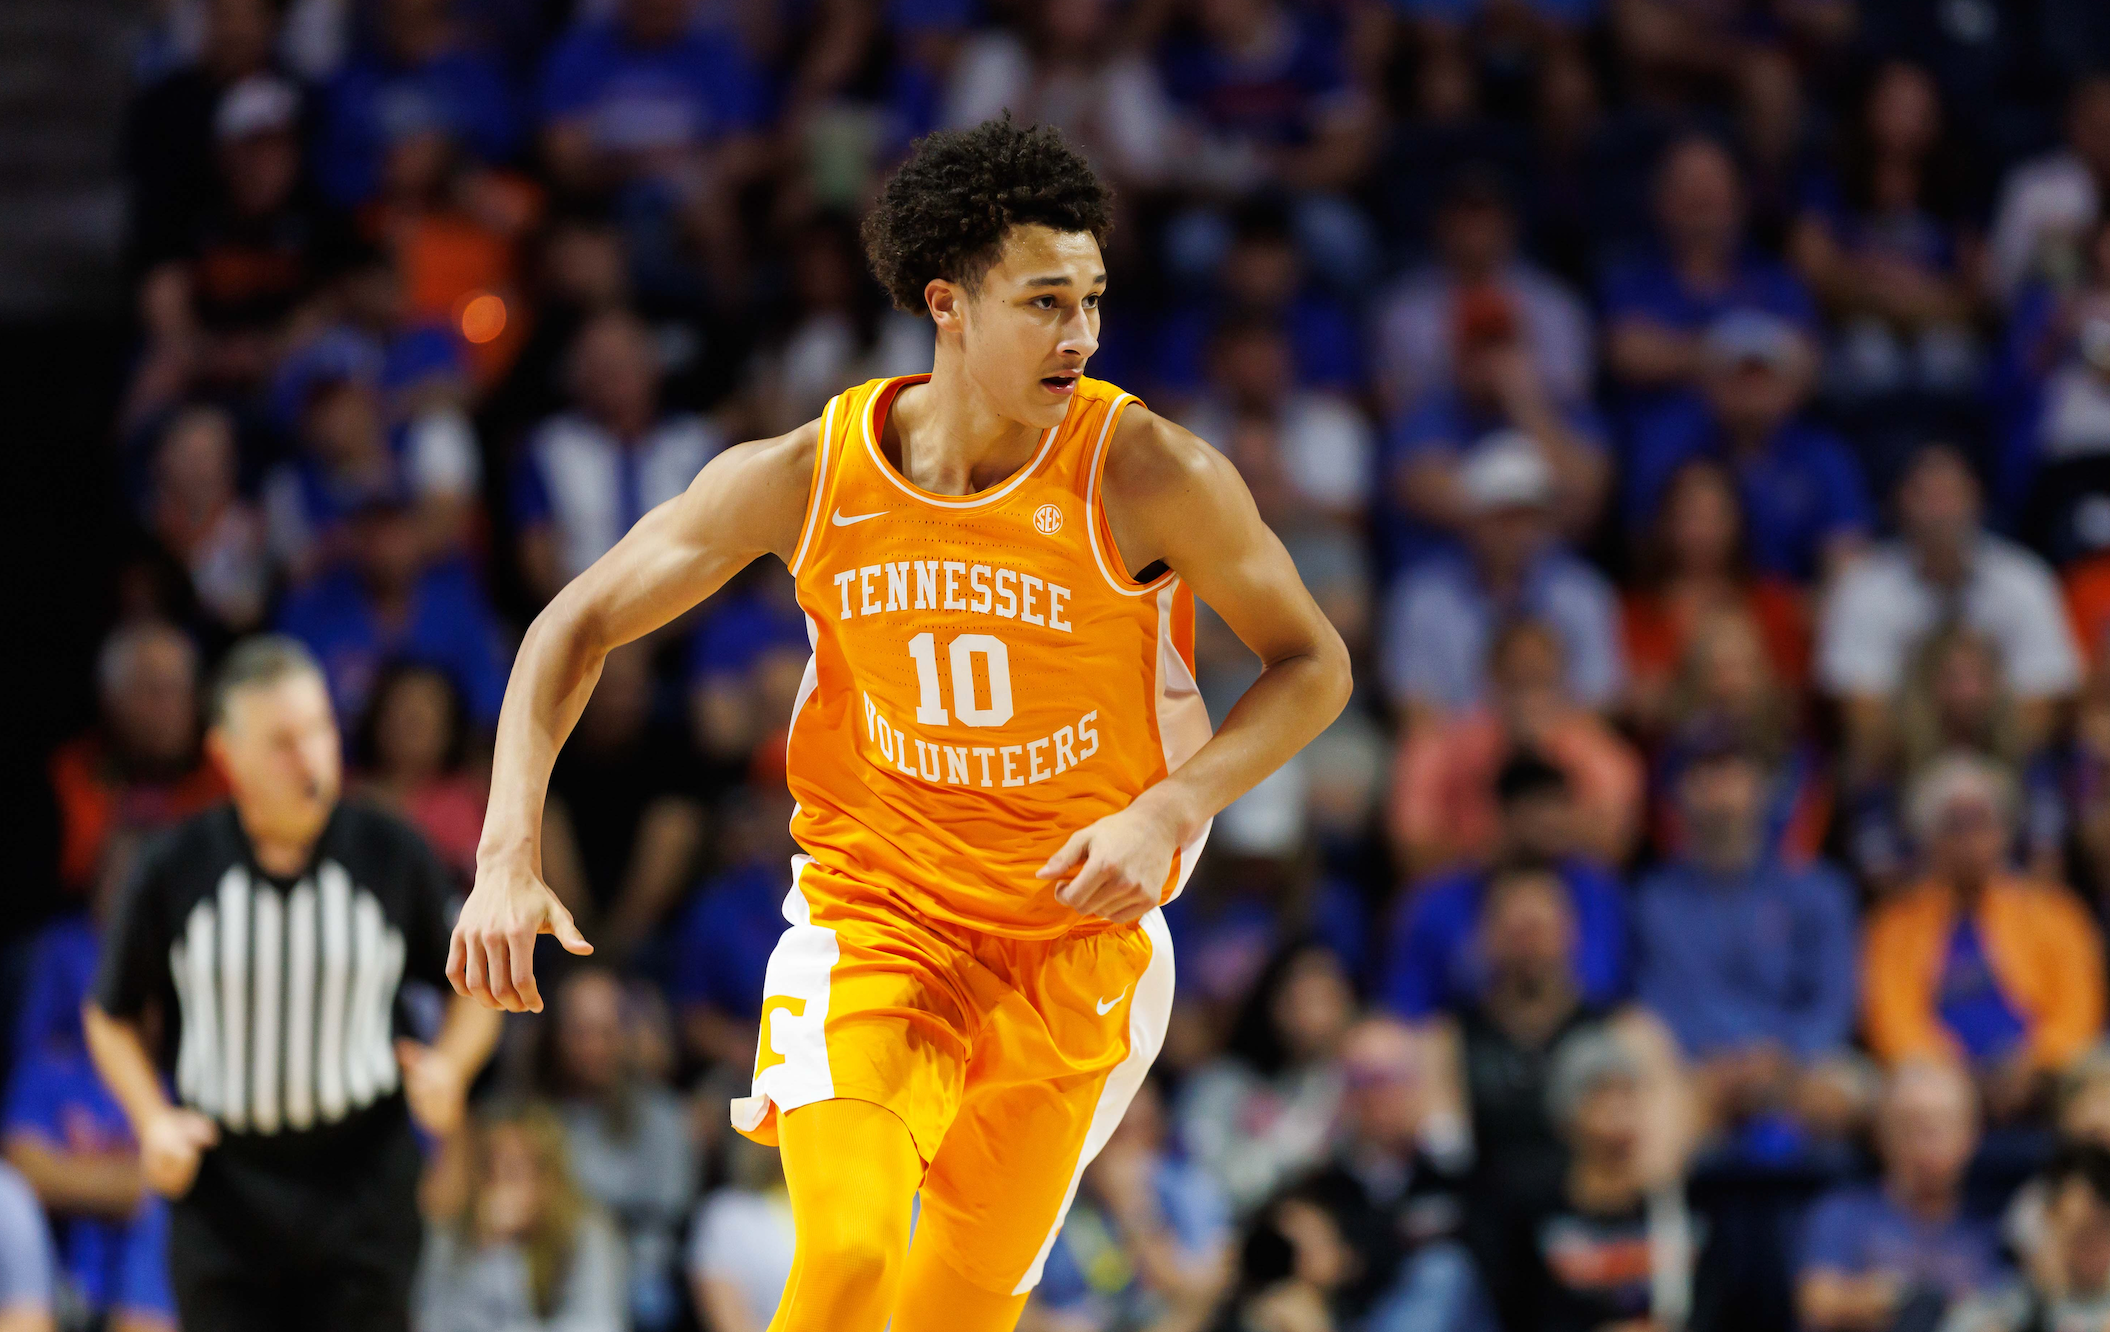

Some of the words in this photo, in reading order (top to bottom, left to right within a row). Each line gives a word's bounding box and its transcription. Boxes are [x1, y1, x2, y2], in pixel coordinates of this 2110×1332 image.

[1036, 506, 1060, 532] SEC
[834, 560, 1072, 633] TENNESSEE
[908, 632, 1014, 727] 10
[863, 690, 1099, 787] VOLUNTEERS
